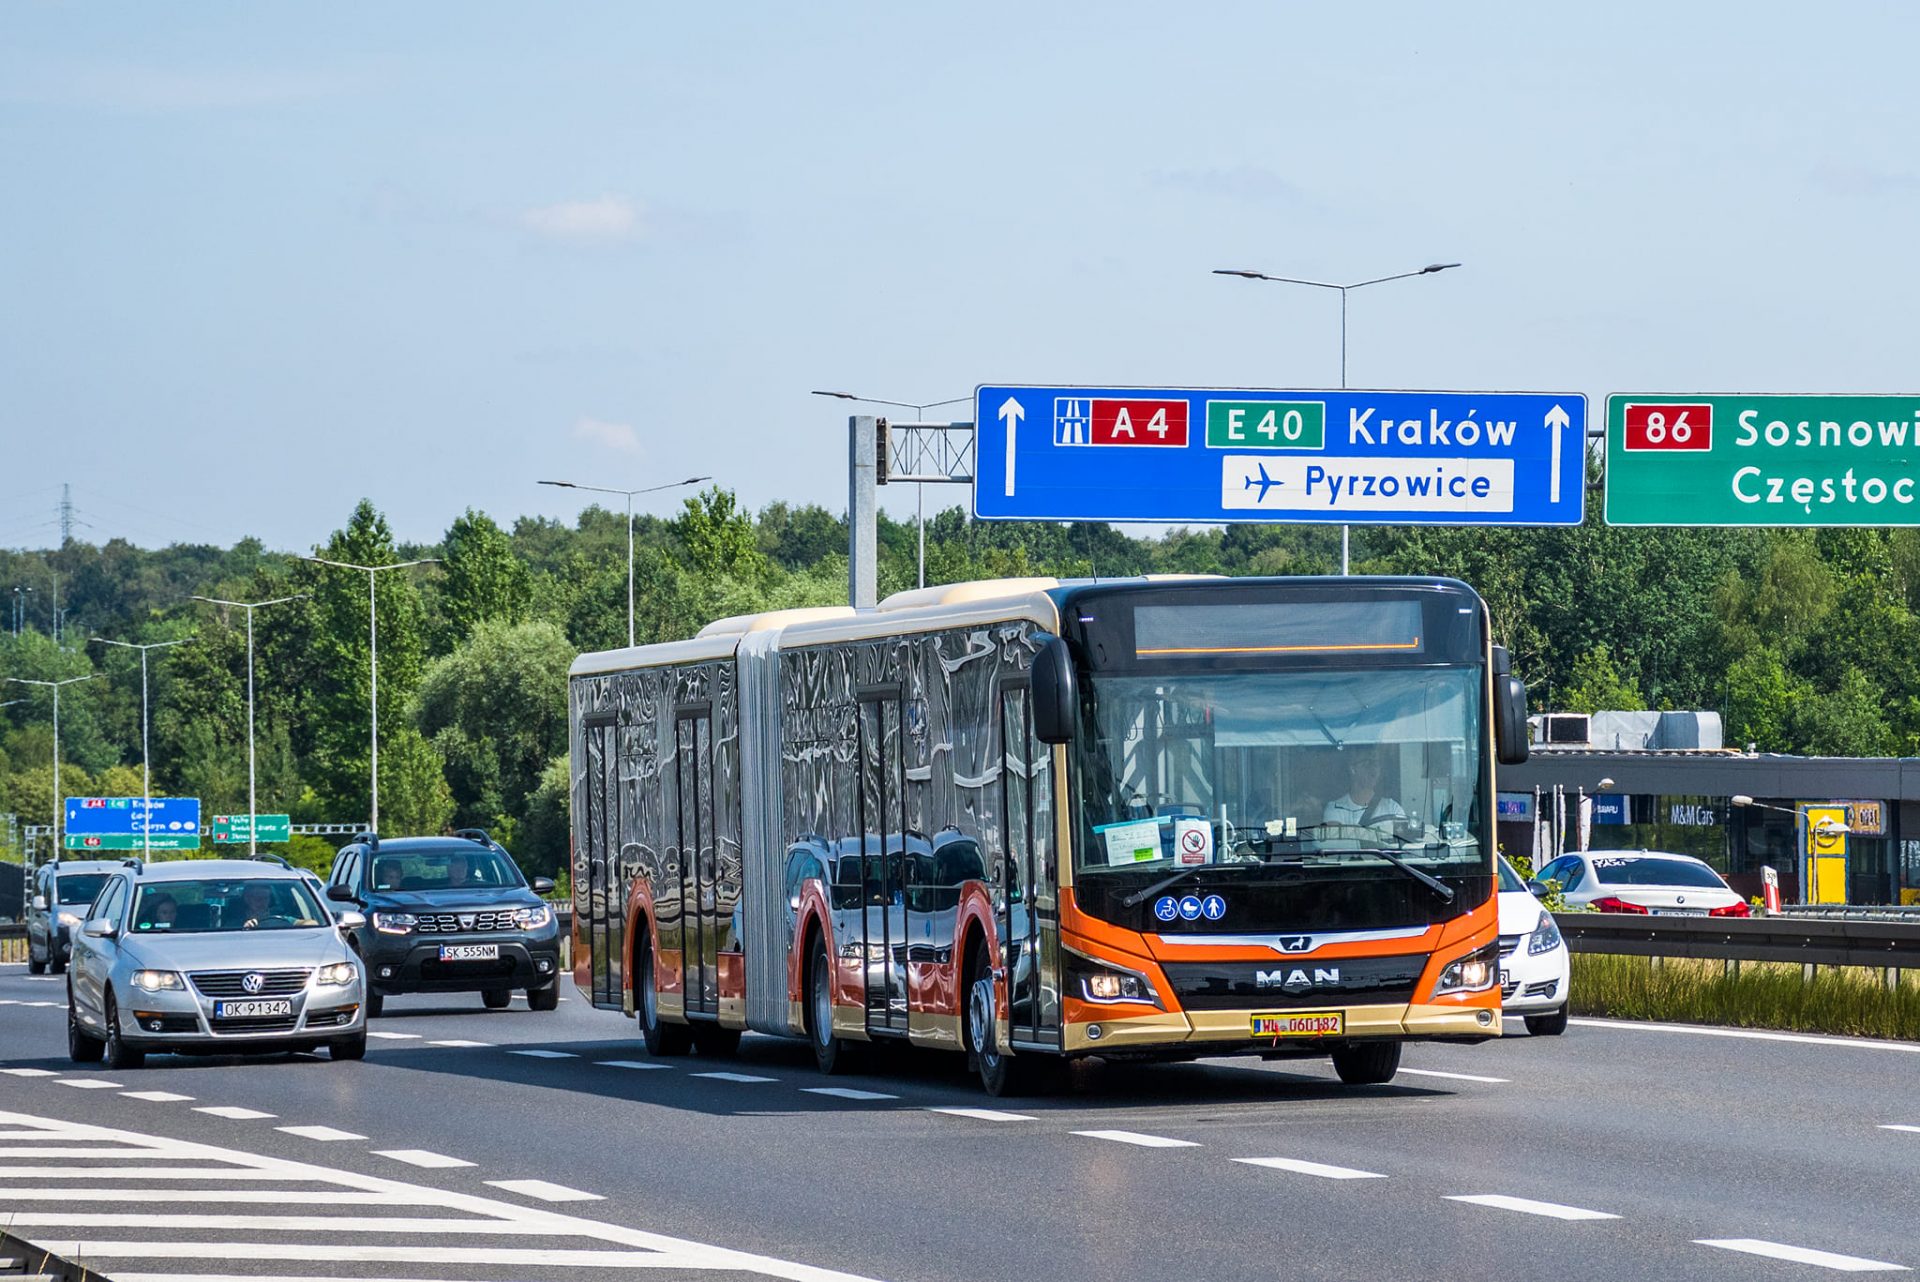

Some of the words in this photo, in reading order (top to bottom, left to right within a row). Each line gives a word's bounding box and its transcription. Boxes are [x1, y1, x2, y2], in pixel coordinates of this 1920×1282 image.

[1111, 407, 1136, 438] A
[1147, 407, 1169, 439] 4
[1228, 409, 1246, 440] E
[1257, 409, 1303, 441] 40
[1349, 407, 1517, 446] Kraków
[1646, 410, 1693, 444] 86
[1305, 465, 1490, 506] Pyrzowice
[1731, 466, 1916, 514] Częstoc
[1671, 804, 1695, 825] M&M
[1696, 805, 1714, 826] Cars
[446, 947, 460, 958] SK
[463, 945, 496, 958] 555NM
[1256, 968, 1340, 988] MAN
[225, 1002, 242, 1017] OK
[247, 1001, 288, 1016] 91342
[1289, 1016, 1338, 1033] 060182
